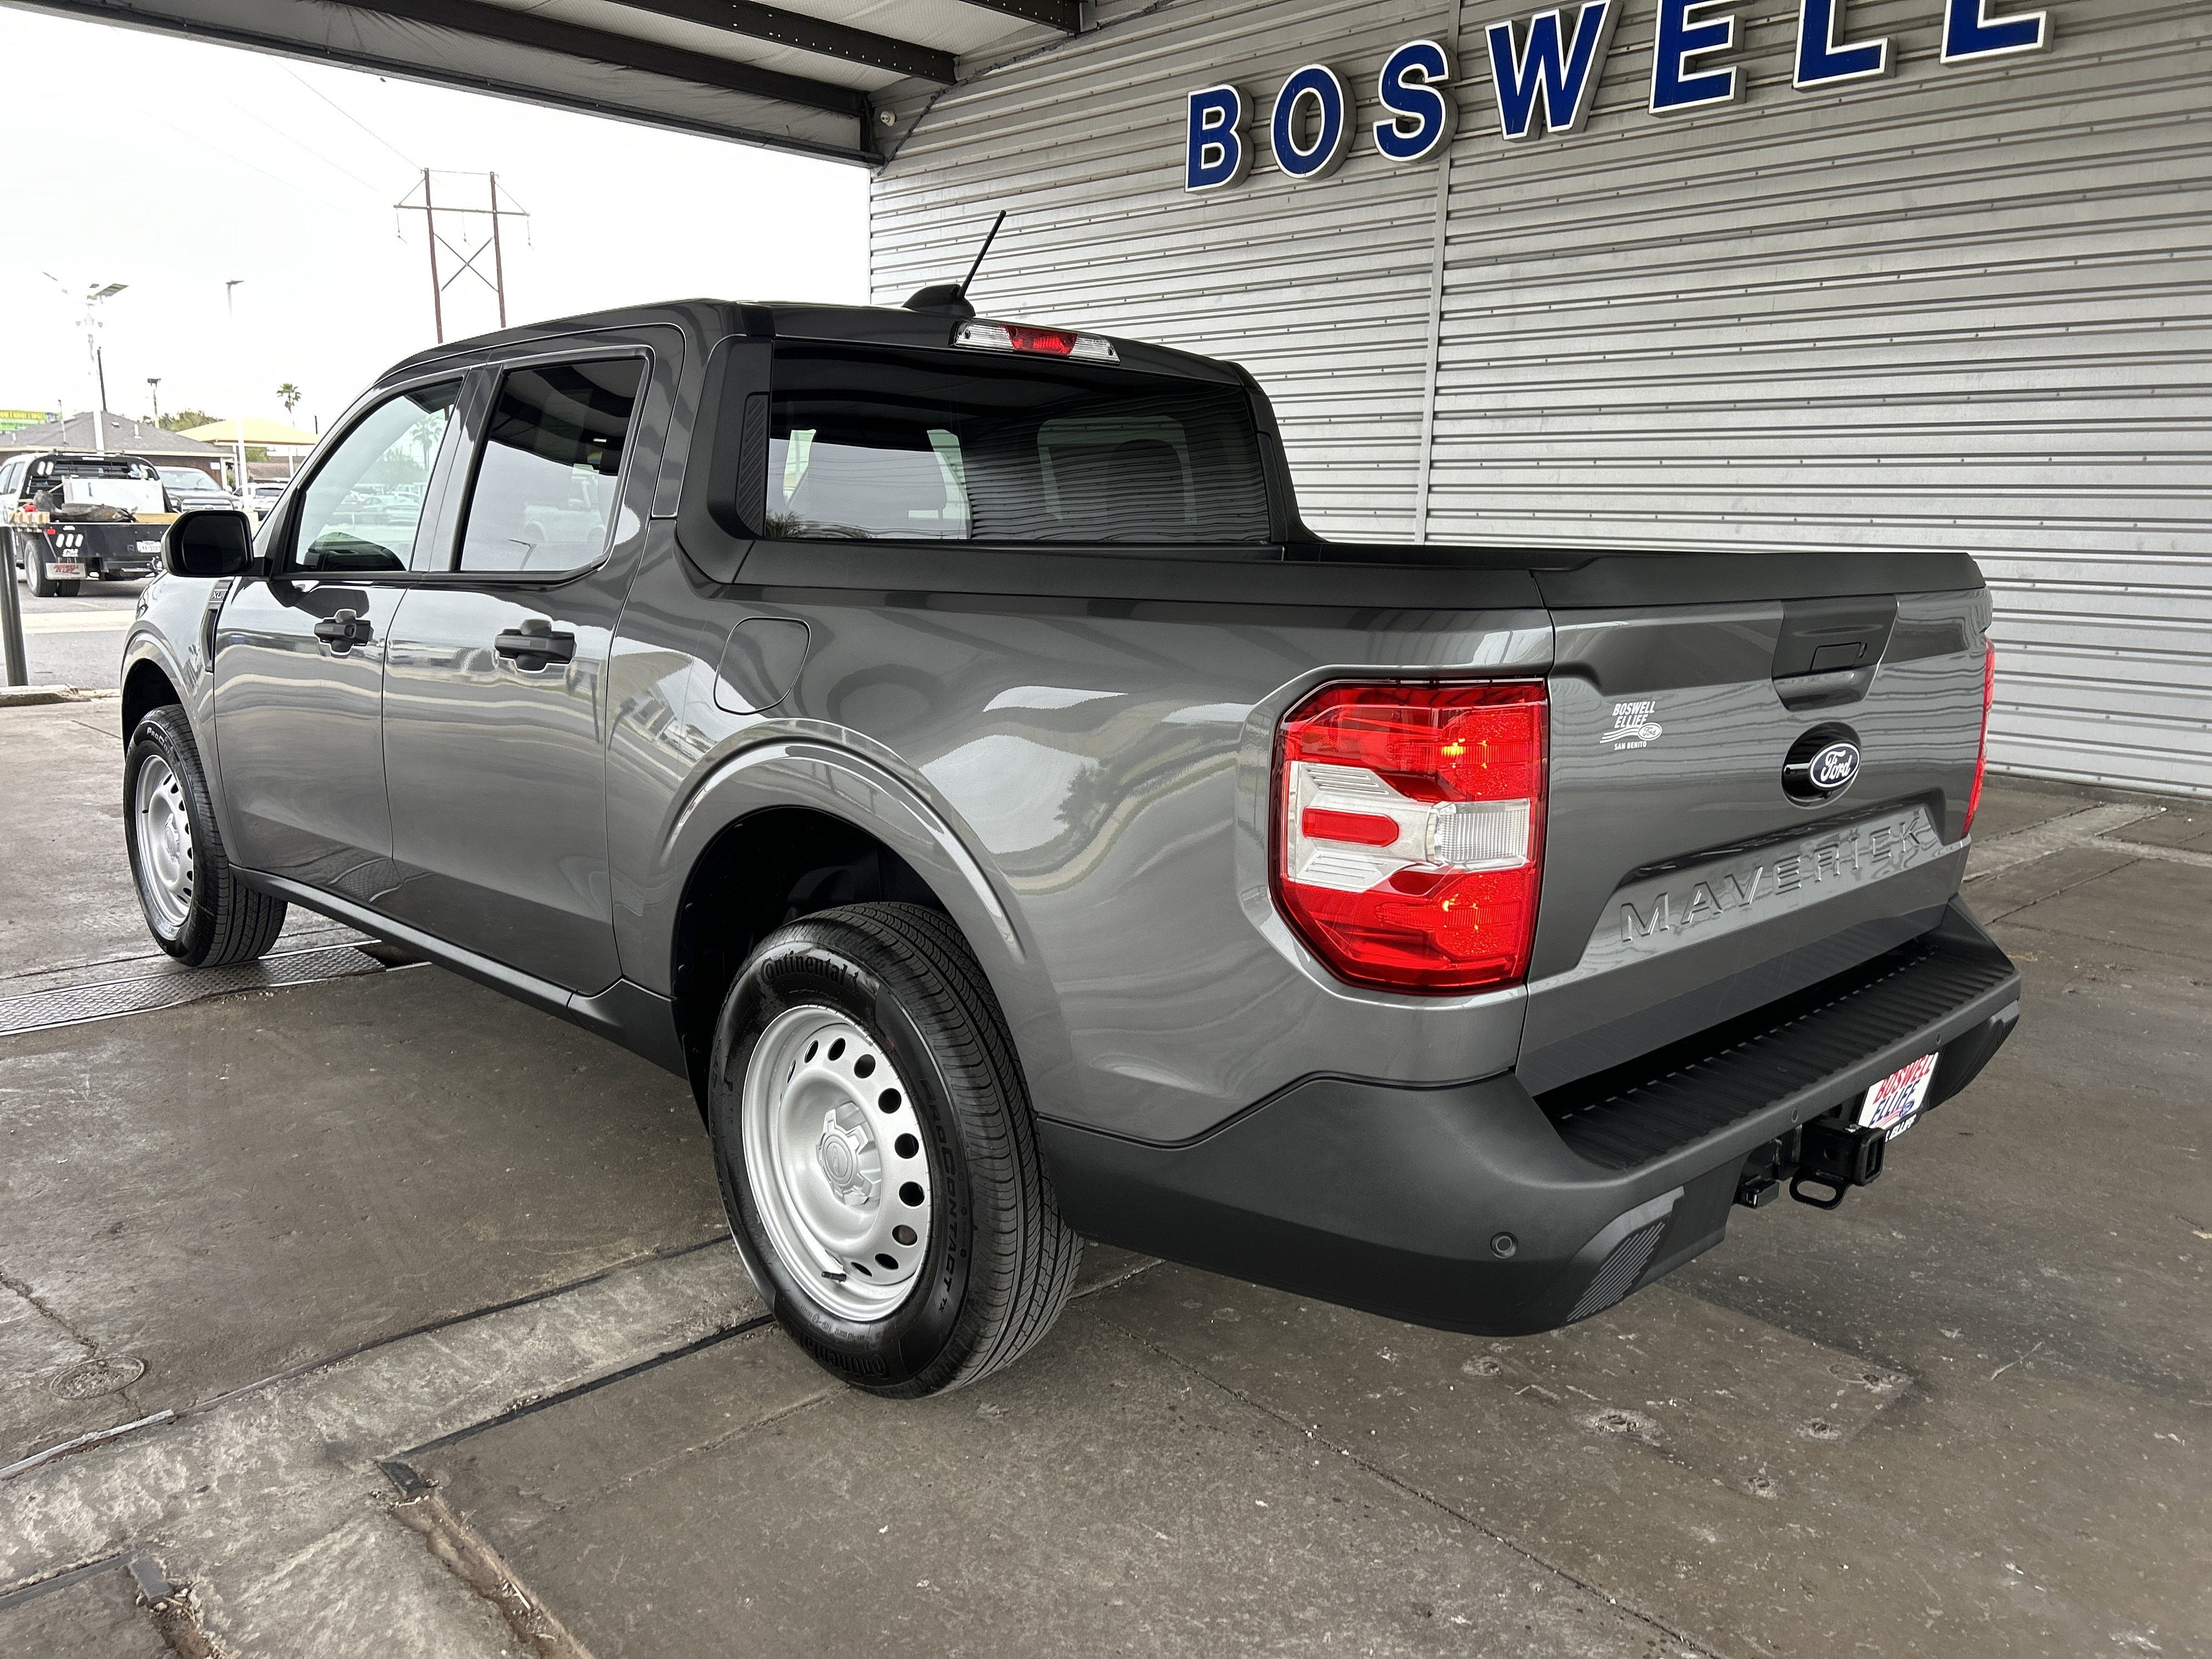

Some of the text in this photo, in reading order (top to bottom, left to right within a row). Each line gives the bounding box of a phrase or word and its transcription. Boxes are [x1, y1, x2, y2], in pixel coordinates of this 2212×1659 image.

[1612, 701, 1655, 716] BOSWELL
[1614, 714, 1648, 729] ELLIFF
[1614, 741, 1647, 751] SAN BENITO
[1620, 816, 1921, 943] MAVERICK
[760, 951, 848, 986] Continental
[1872, 1054, 1934, 1105] BOSWELL
[1869, 1079, 1921, 1127] ELLIFF
